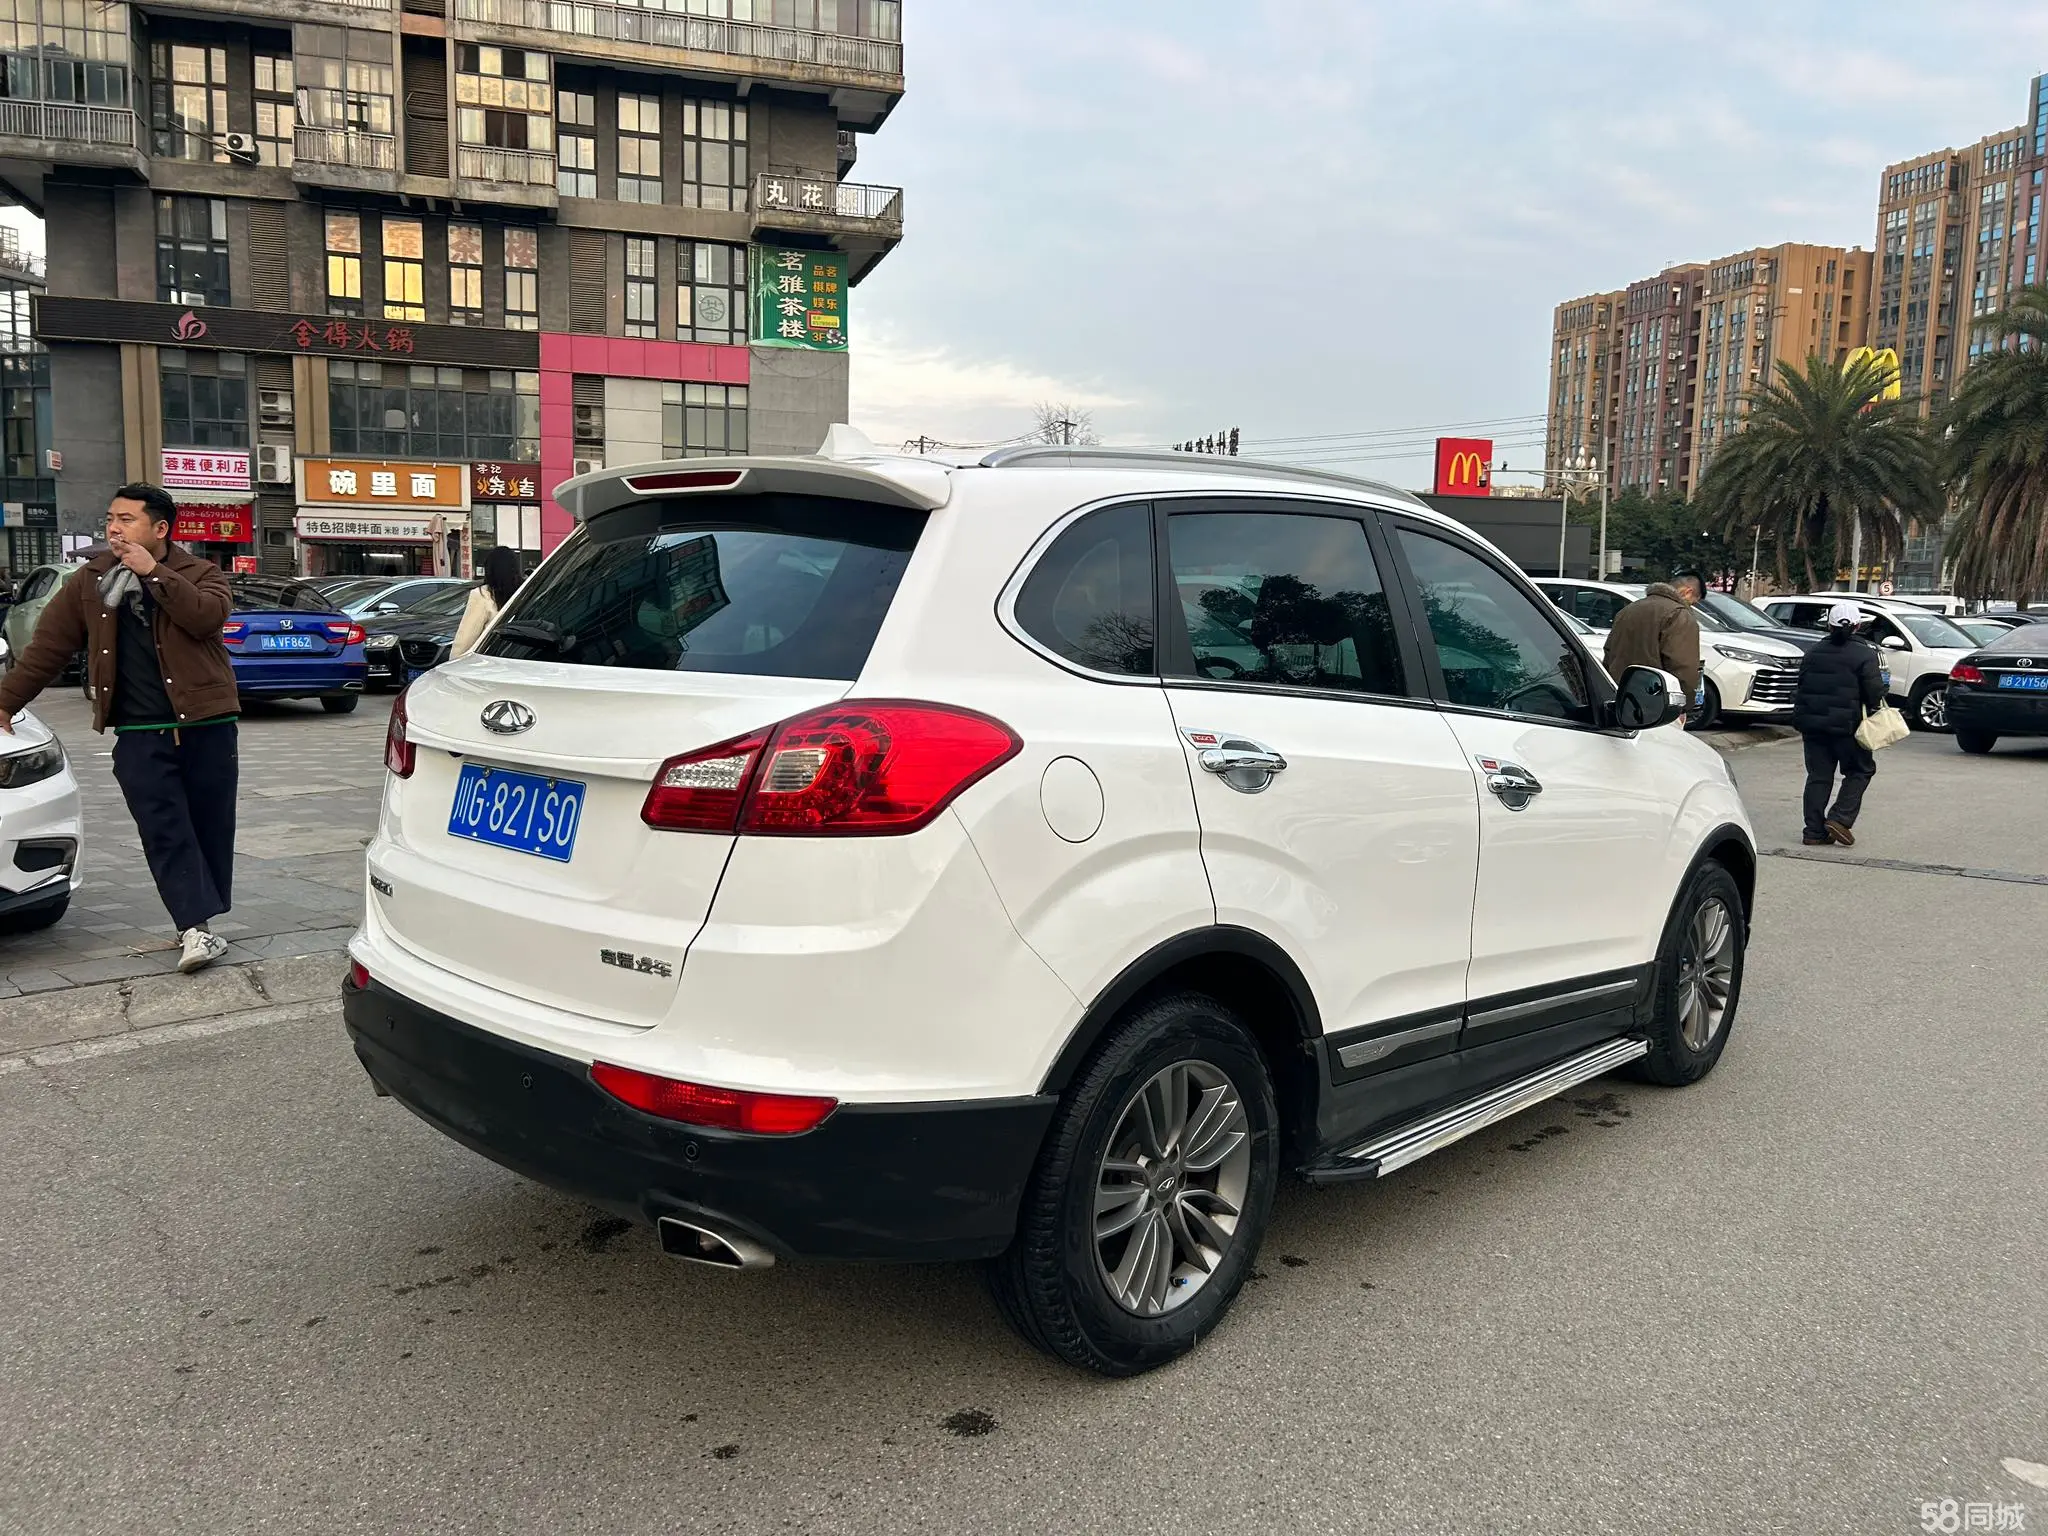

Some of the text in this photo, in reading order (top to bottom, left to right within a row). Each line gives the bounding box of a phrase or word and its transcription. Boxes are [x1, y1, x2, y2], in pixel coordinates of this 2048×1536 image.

[813, 265, 837, 277] 品茗
[813, 281, 838, 293] 棋牌
[777, 252, 807, 338] 茗雅茶楼
[813, 297, 838, 309] 娱乐
[288, 319, 414, 353] 舍得火锅
[812, 332, 826, 341] 3F
[165, 457, 247, 474] 蓉雅便利店
[329, 470, 437, 498] 碗里面
[476, 475, 535, 498] 烧烤
[306, 521, 382, 535] 特色招牌拌面
[1884, 584, 1890, 593] 5
